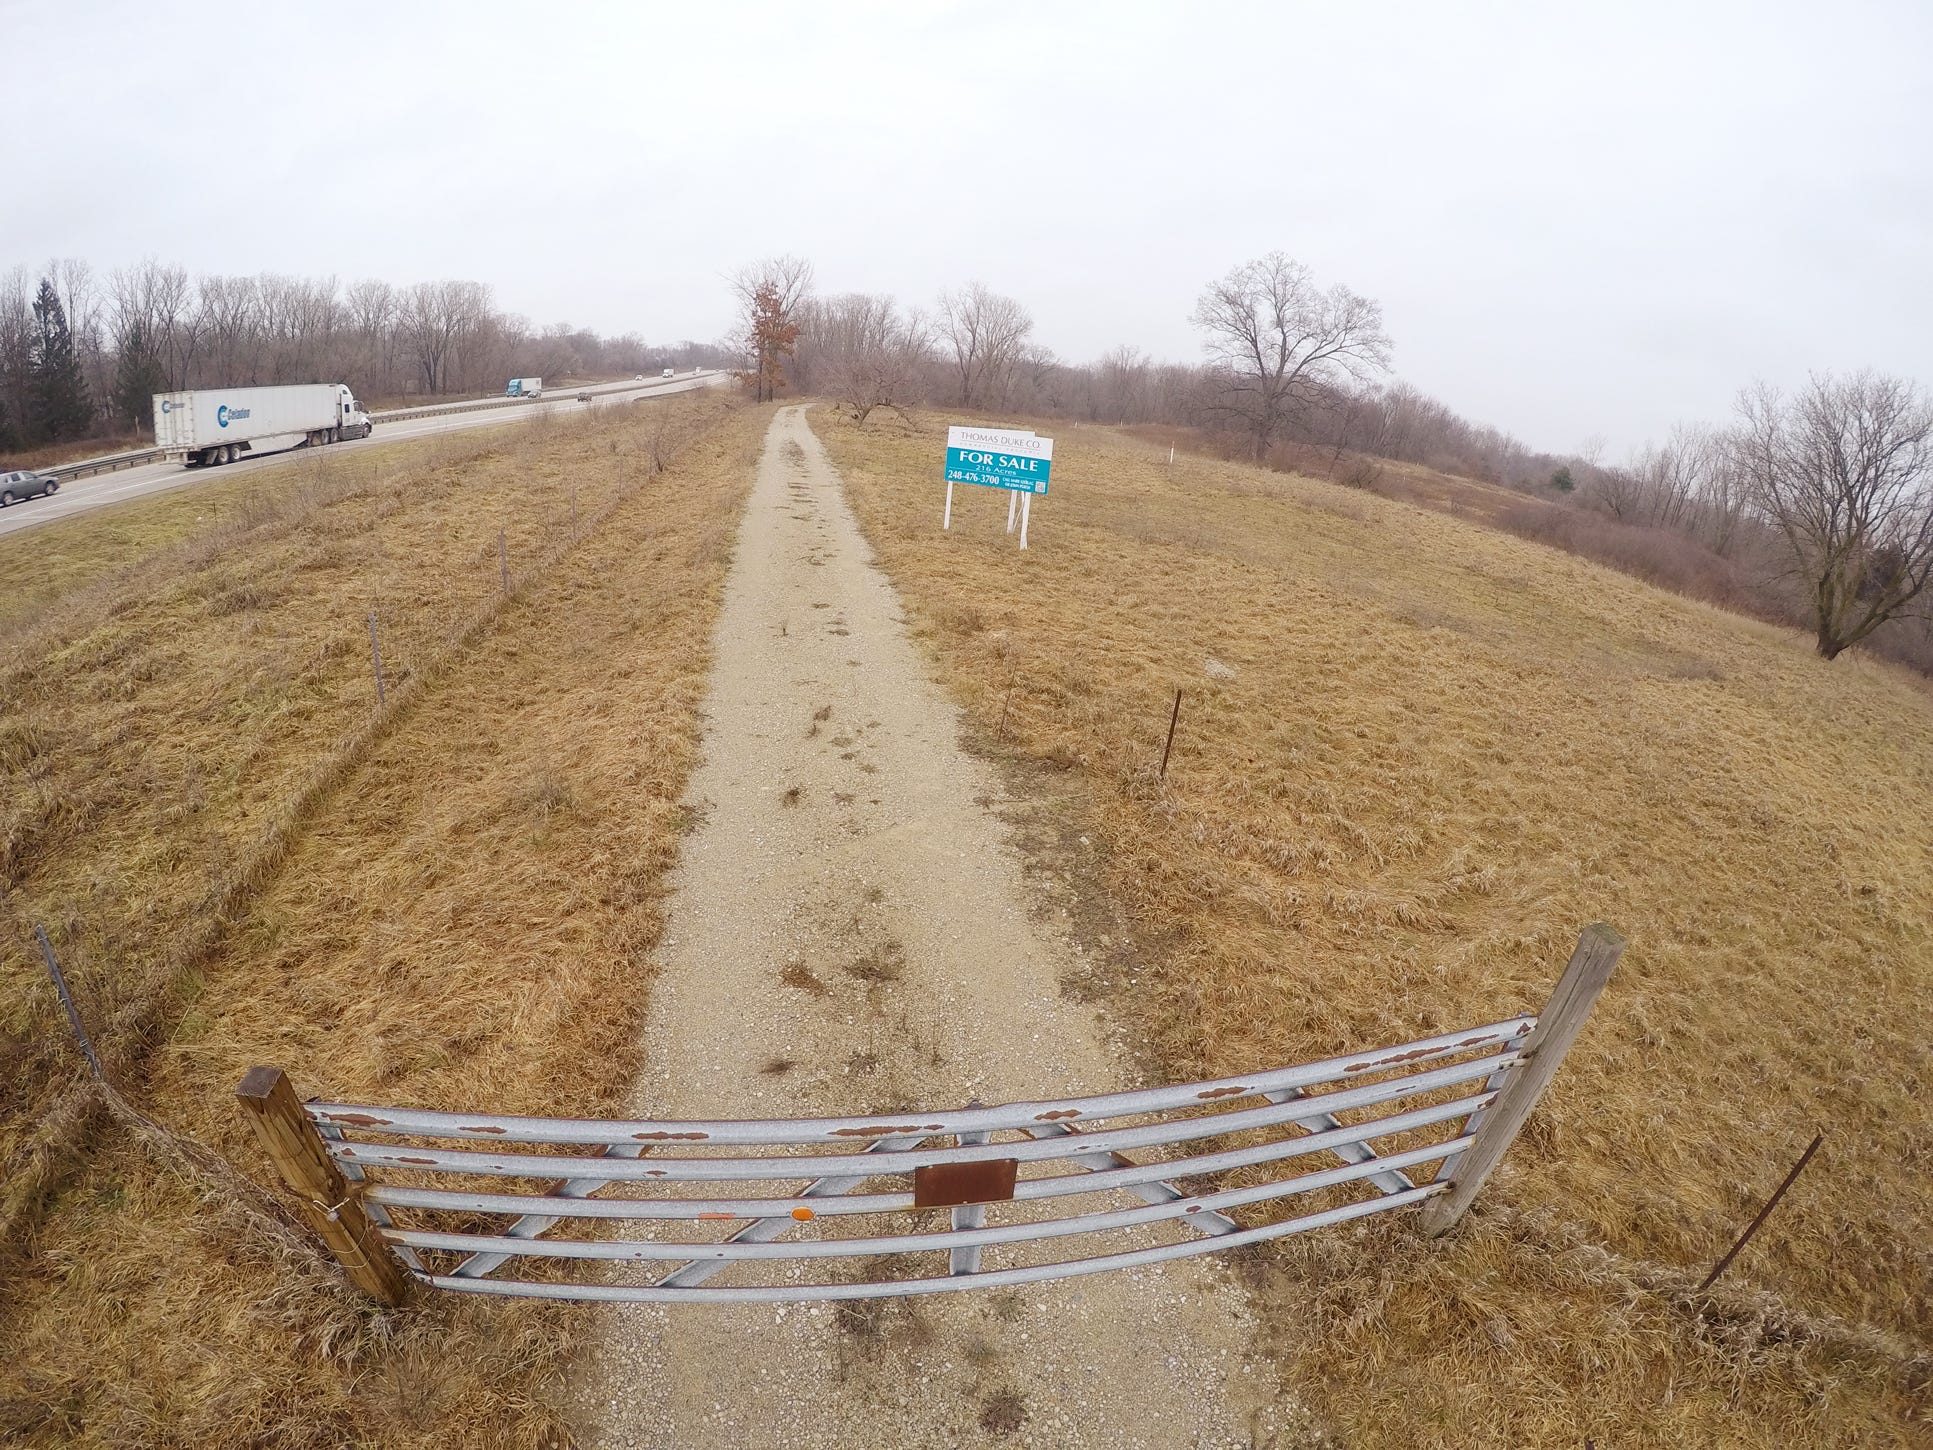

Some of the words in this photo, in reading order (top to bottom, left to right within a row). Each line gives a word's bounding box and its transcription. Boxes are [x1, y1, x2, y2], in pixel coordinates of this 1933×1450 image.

[961, 431, 999, 443] THOMAS
[1001, 437, 1024, 447] DUKE
[959, 451, 994, 465] FOR
[999, 456, 1039, 472] SALE
[948, 470, 1000, 485] 248-476-3700
[976, 464, 992, 472] 216
[993, 466, 1017, 476] Acres
